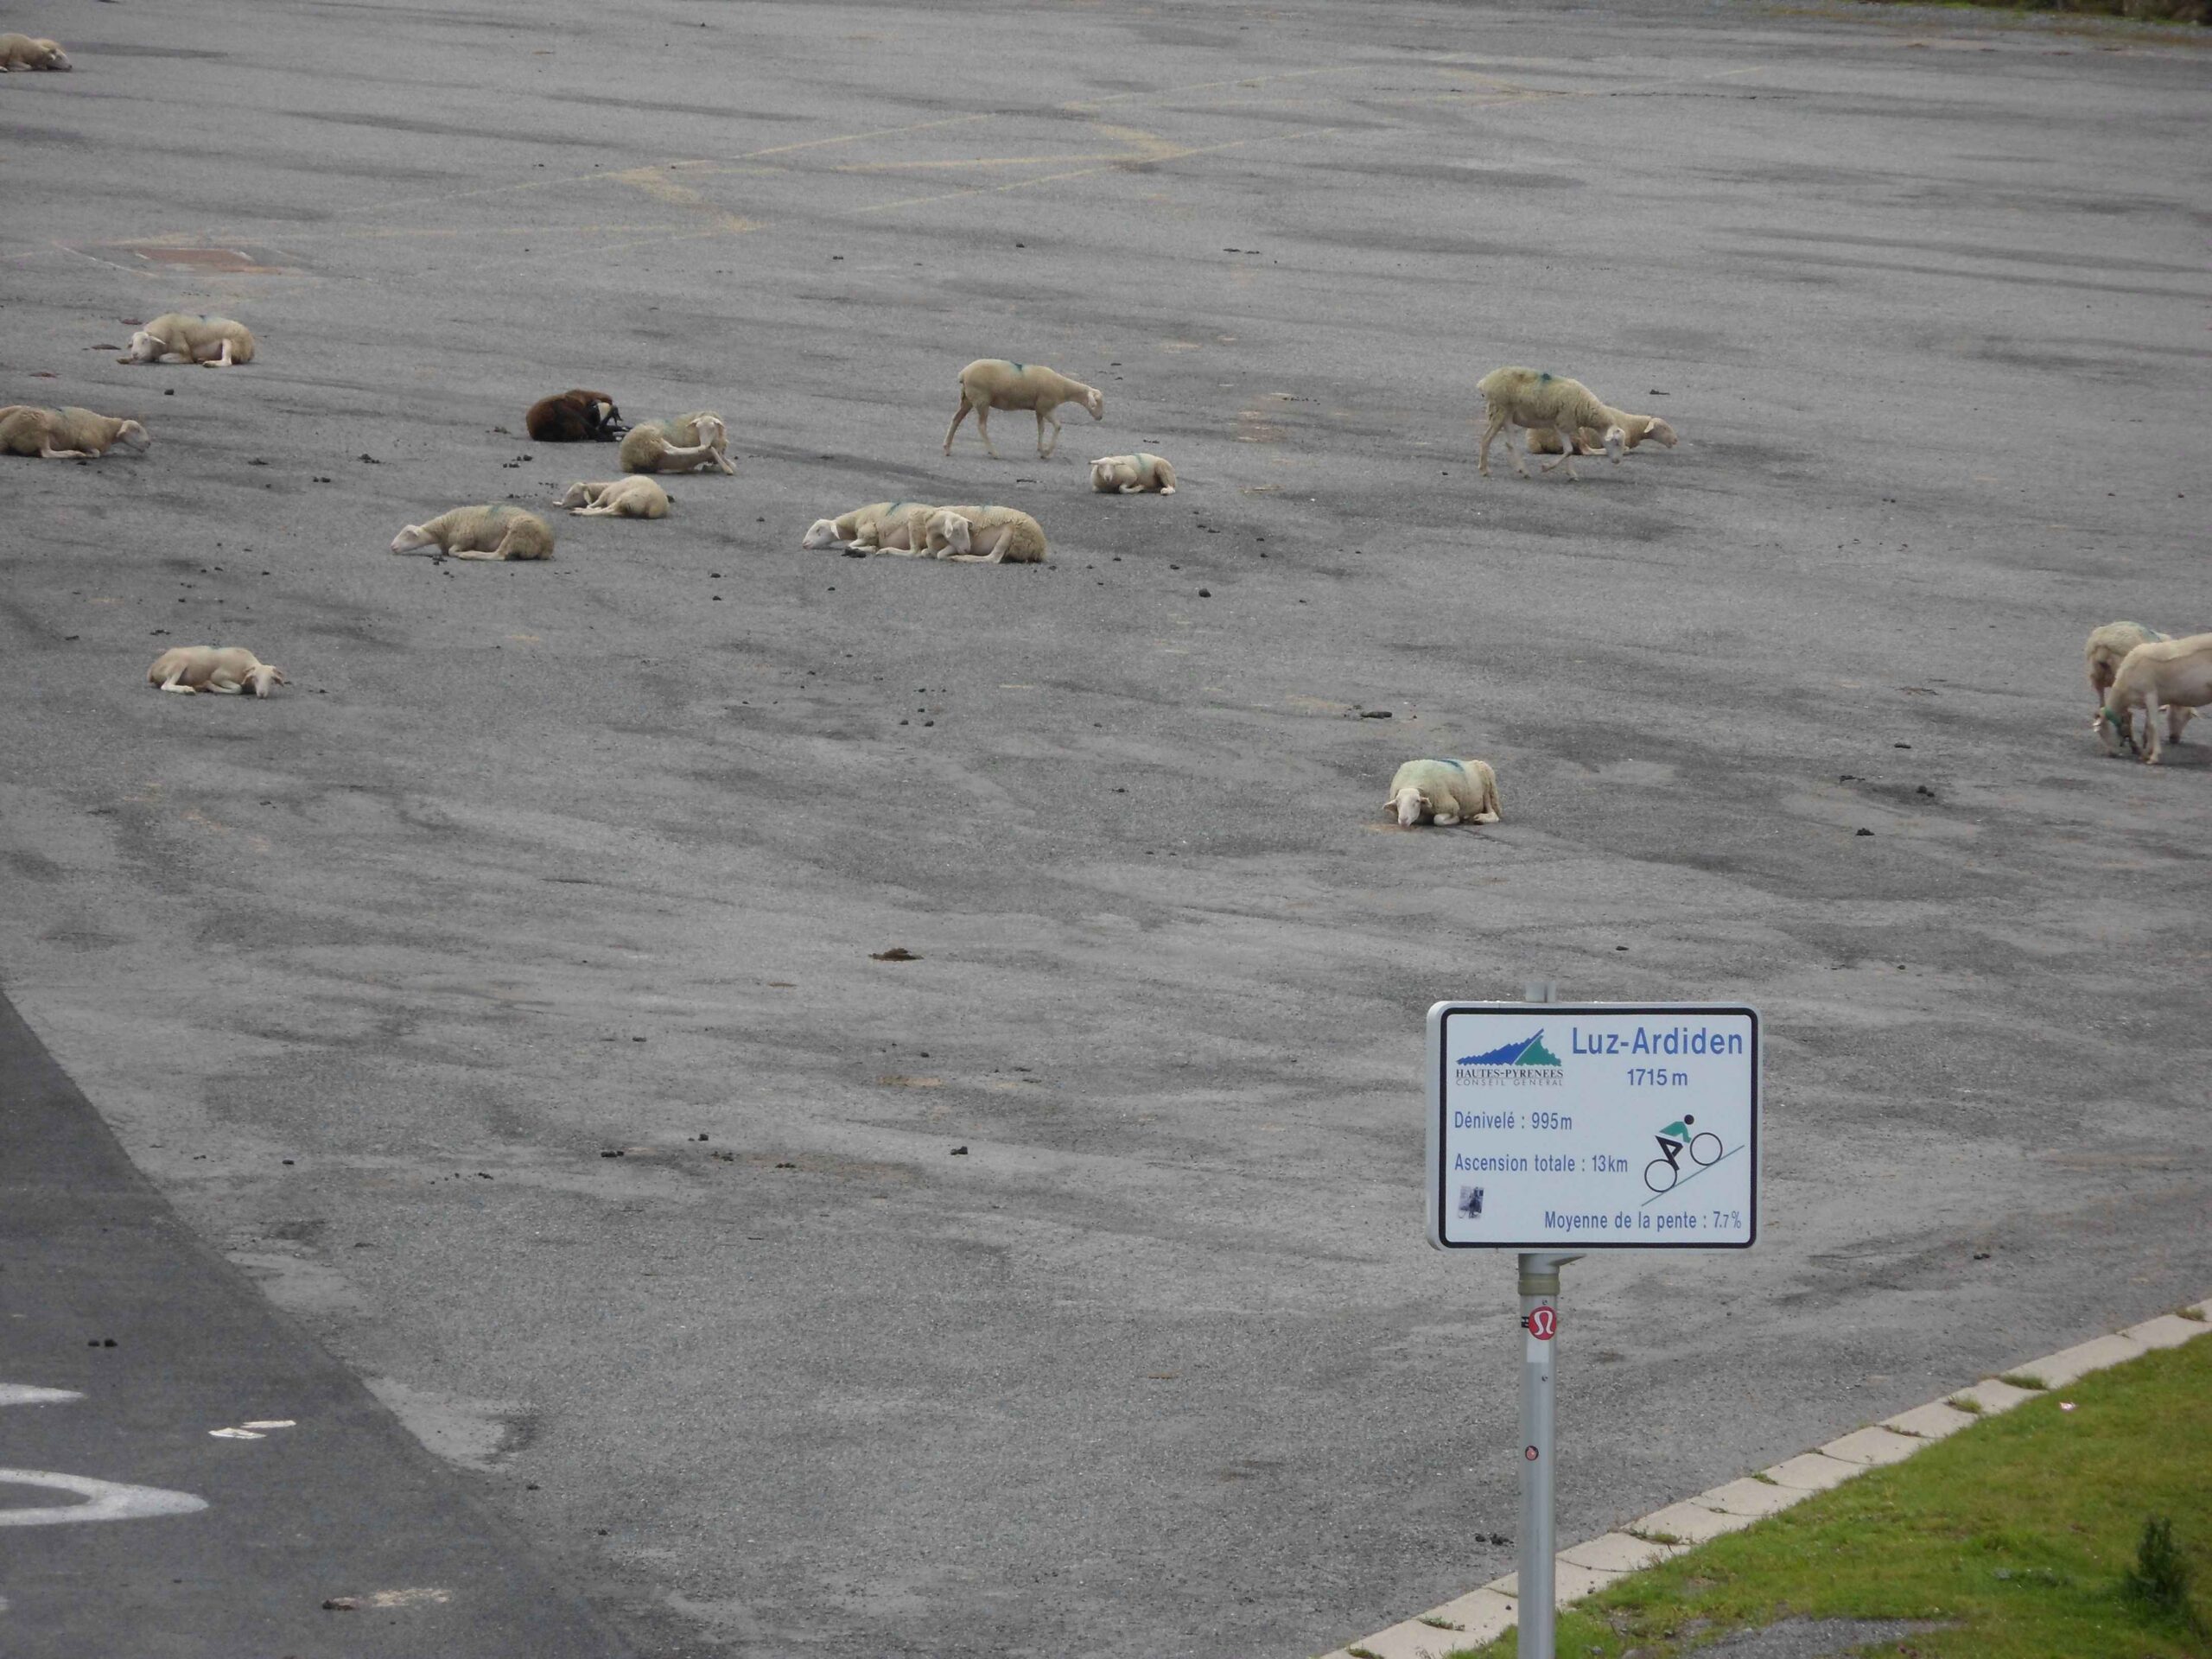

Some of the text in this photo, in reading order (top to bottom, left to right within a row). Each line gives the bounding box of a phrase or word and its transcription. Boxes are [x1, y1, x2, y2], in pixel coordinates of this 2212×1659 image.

[1573, 1027, 1743, 1055] Luz-Ardiden
[1627, 1068, 1668, 1086] 1715
[1454, 1111, 1515, 1129] Dénivelé
[1454, 1154, 1528, 1172] Ascension
[1535, 1154, 1575, 1172] totale
[1544, 1211, 1608, 1232] Moyenne
[1614, 1211, 1632, 1229] de
[1638, 1211, 1650, 1229] la
[1656, 1211, 1697, 1232] pente
